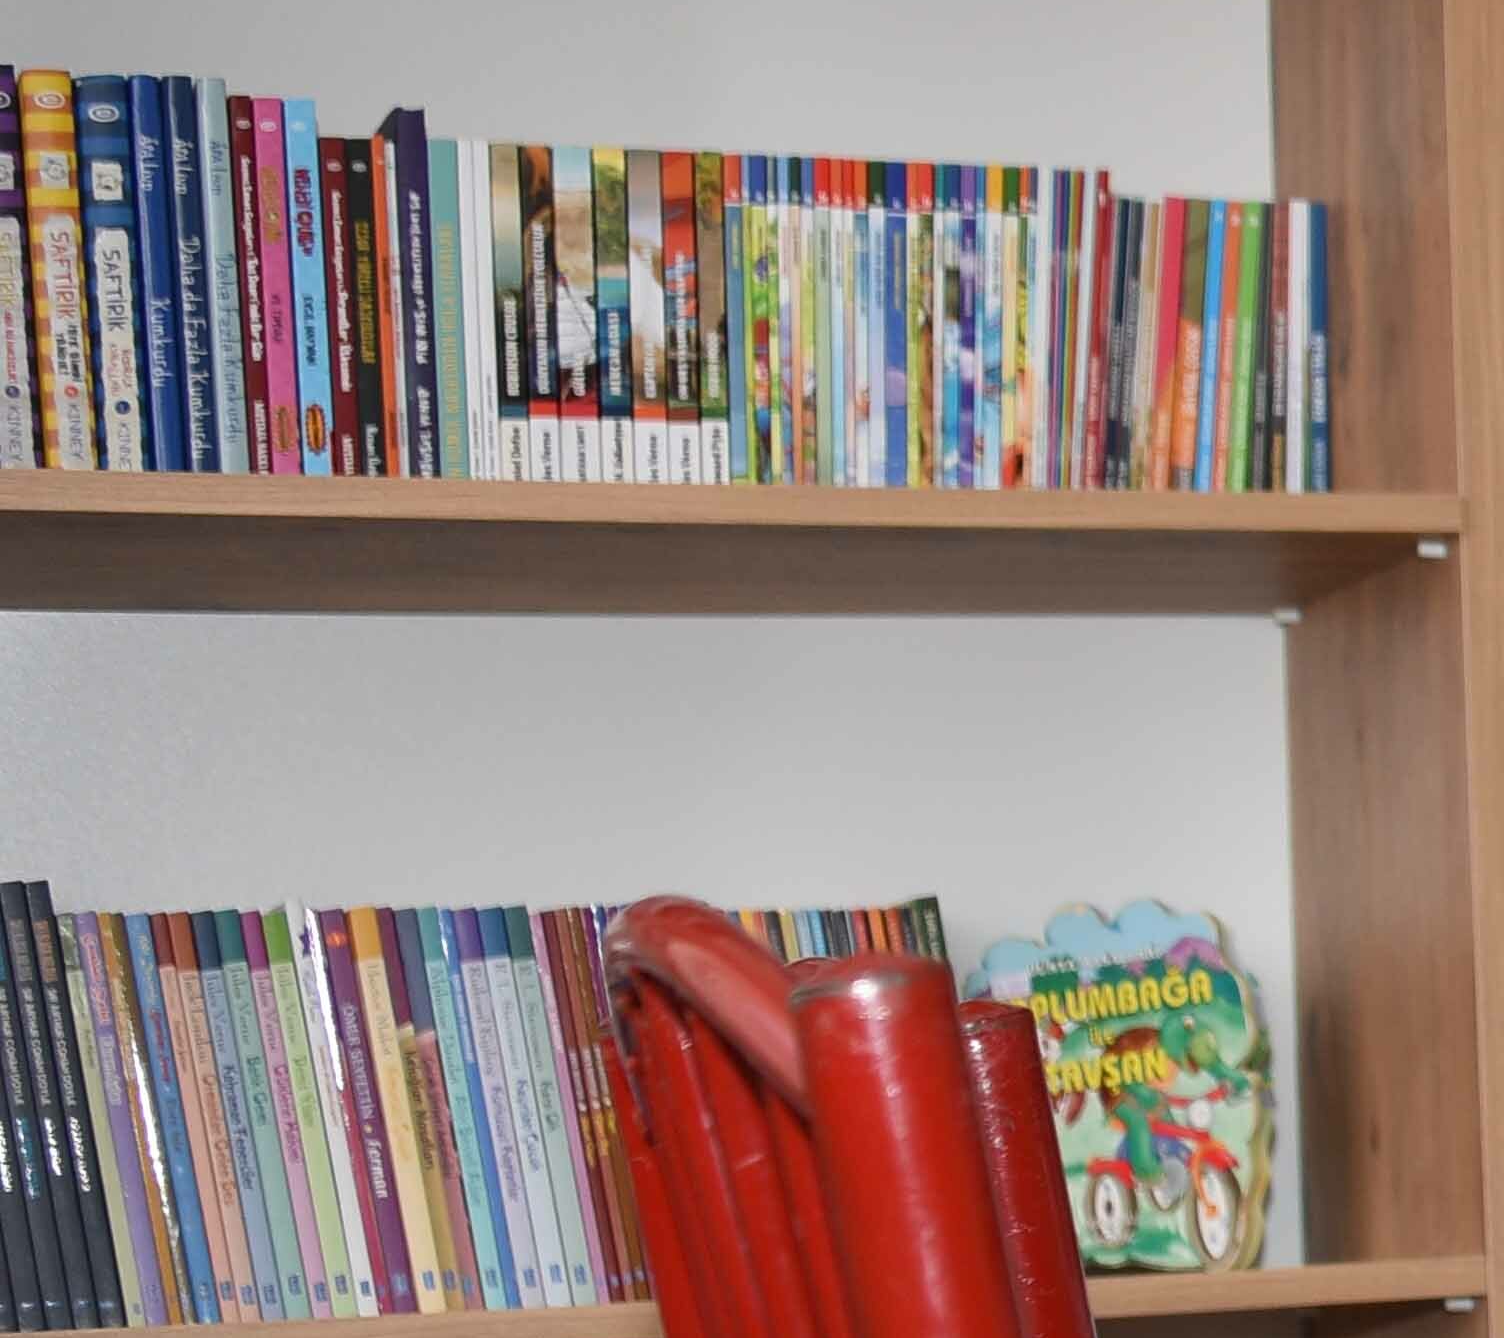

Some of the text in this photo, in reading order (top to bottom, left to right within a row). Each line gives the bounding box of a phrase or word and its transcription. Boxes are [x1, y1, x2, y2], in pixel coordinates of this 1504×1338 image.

[102, 248, 128, 331] SAFTİRİK
[50, 230, 86, 459] SAFTİRİK KINNEY
[150, 296, 173, 388] Kumkurdu
[180, 236, 213, 459] Daha da Fazla Kumkurdu
[222, 359, 243, 444] Kumkurdu
[30, 1039, 46, 1073] CONAN
[55, 1039, 71, 1073] CONAN
[1045, 1048, 1168, 1097] TAVŞAN
[10, 1075, 26, 1106] DOYLE
[37, 1075, 52, 1106] DOYLE
[62, 1075, 77, 1106] DOYLE
[341, 1003, 360, 1046] ÖMER
[367, 1139, 389, 1198] Ferman
